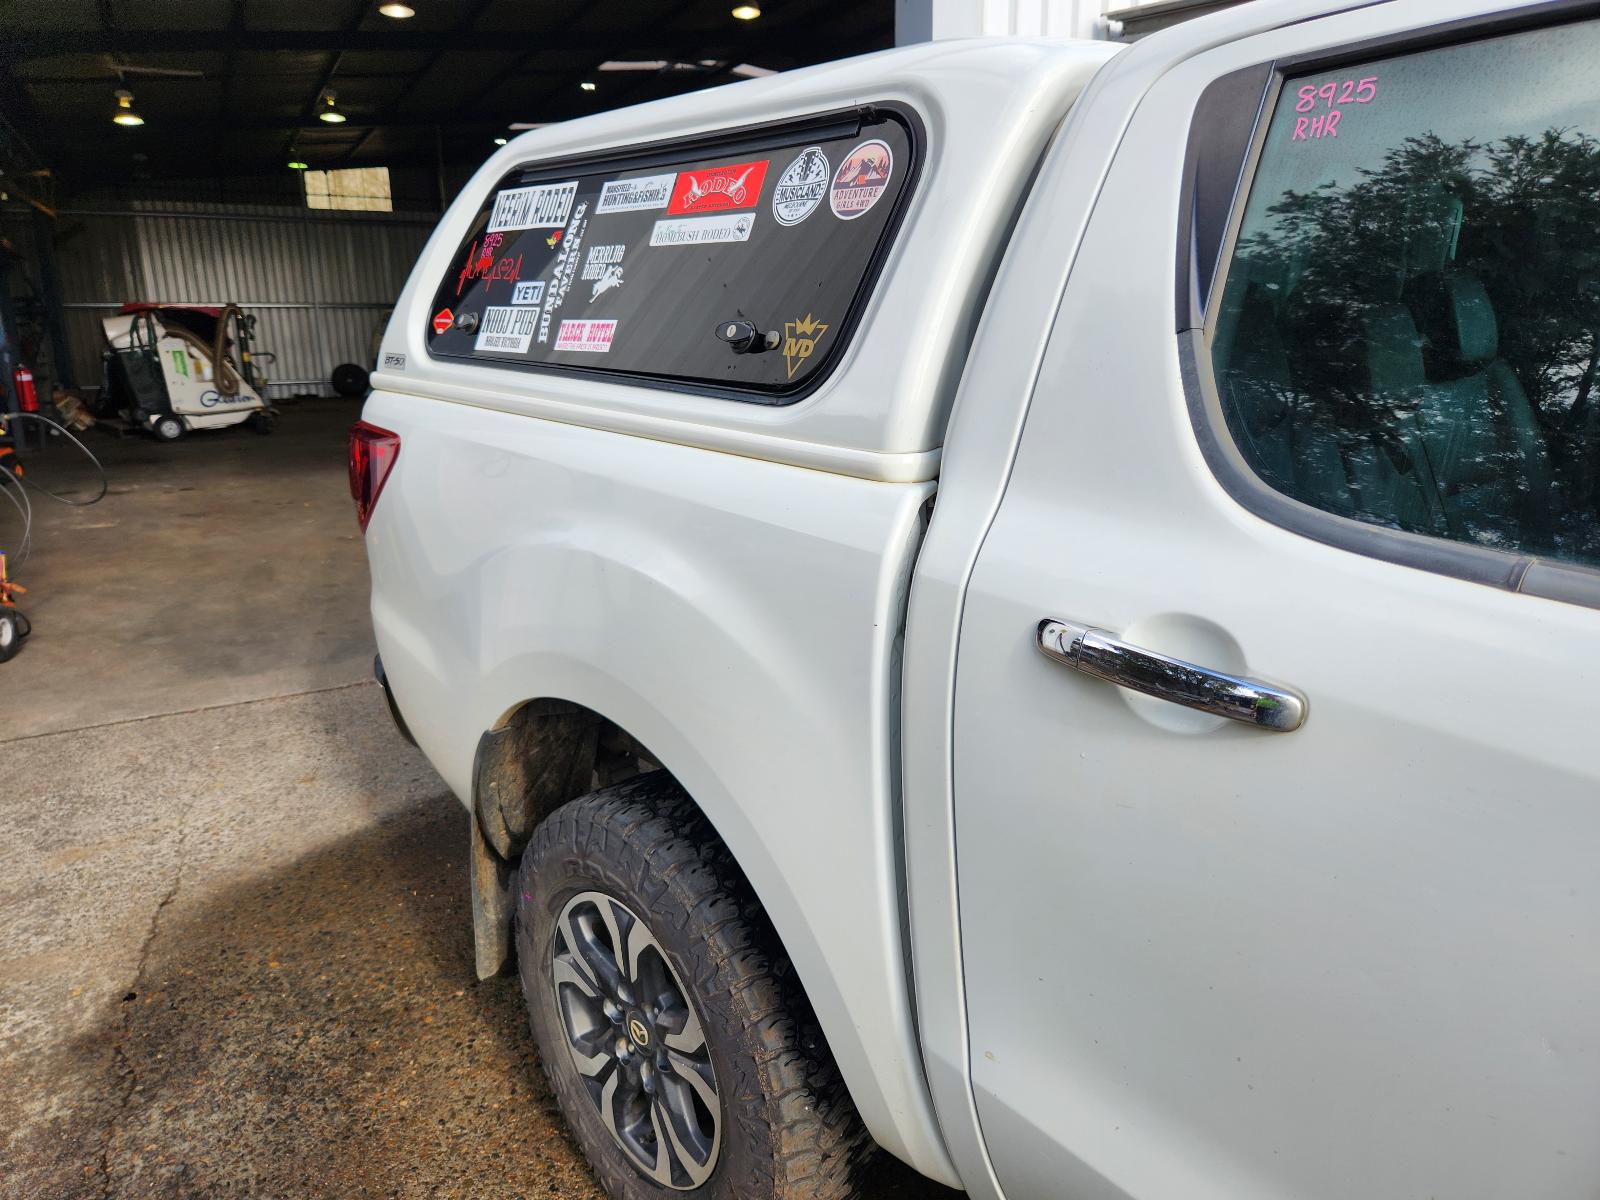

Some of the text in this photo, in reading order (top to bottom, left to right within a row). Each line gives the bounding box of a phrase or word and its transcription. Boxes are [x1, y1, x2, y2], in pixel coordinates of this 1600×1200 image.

[1295, 77, 1378, 112] 8925
[1292, 110, 1341, 140] RHR
[780, 184, 821, 200] MUSICLAND
[834, 188, 879, 200] ADVENTURE
[531, 187, 574, 224] RODEO
[836, 200, 870, 209] GIRLS 4WD
[655, 229, 700, 243] HOMEBUSH
[701, 228, 731, 240] RODEO
[537, 201, 589, 343] BUNDALONG
[517, 286, 542, 300] YETI
[482, 309, 537, 335] NOOJ PUB
[587, 323, 614, 342] HOTEL
